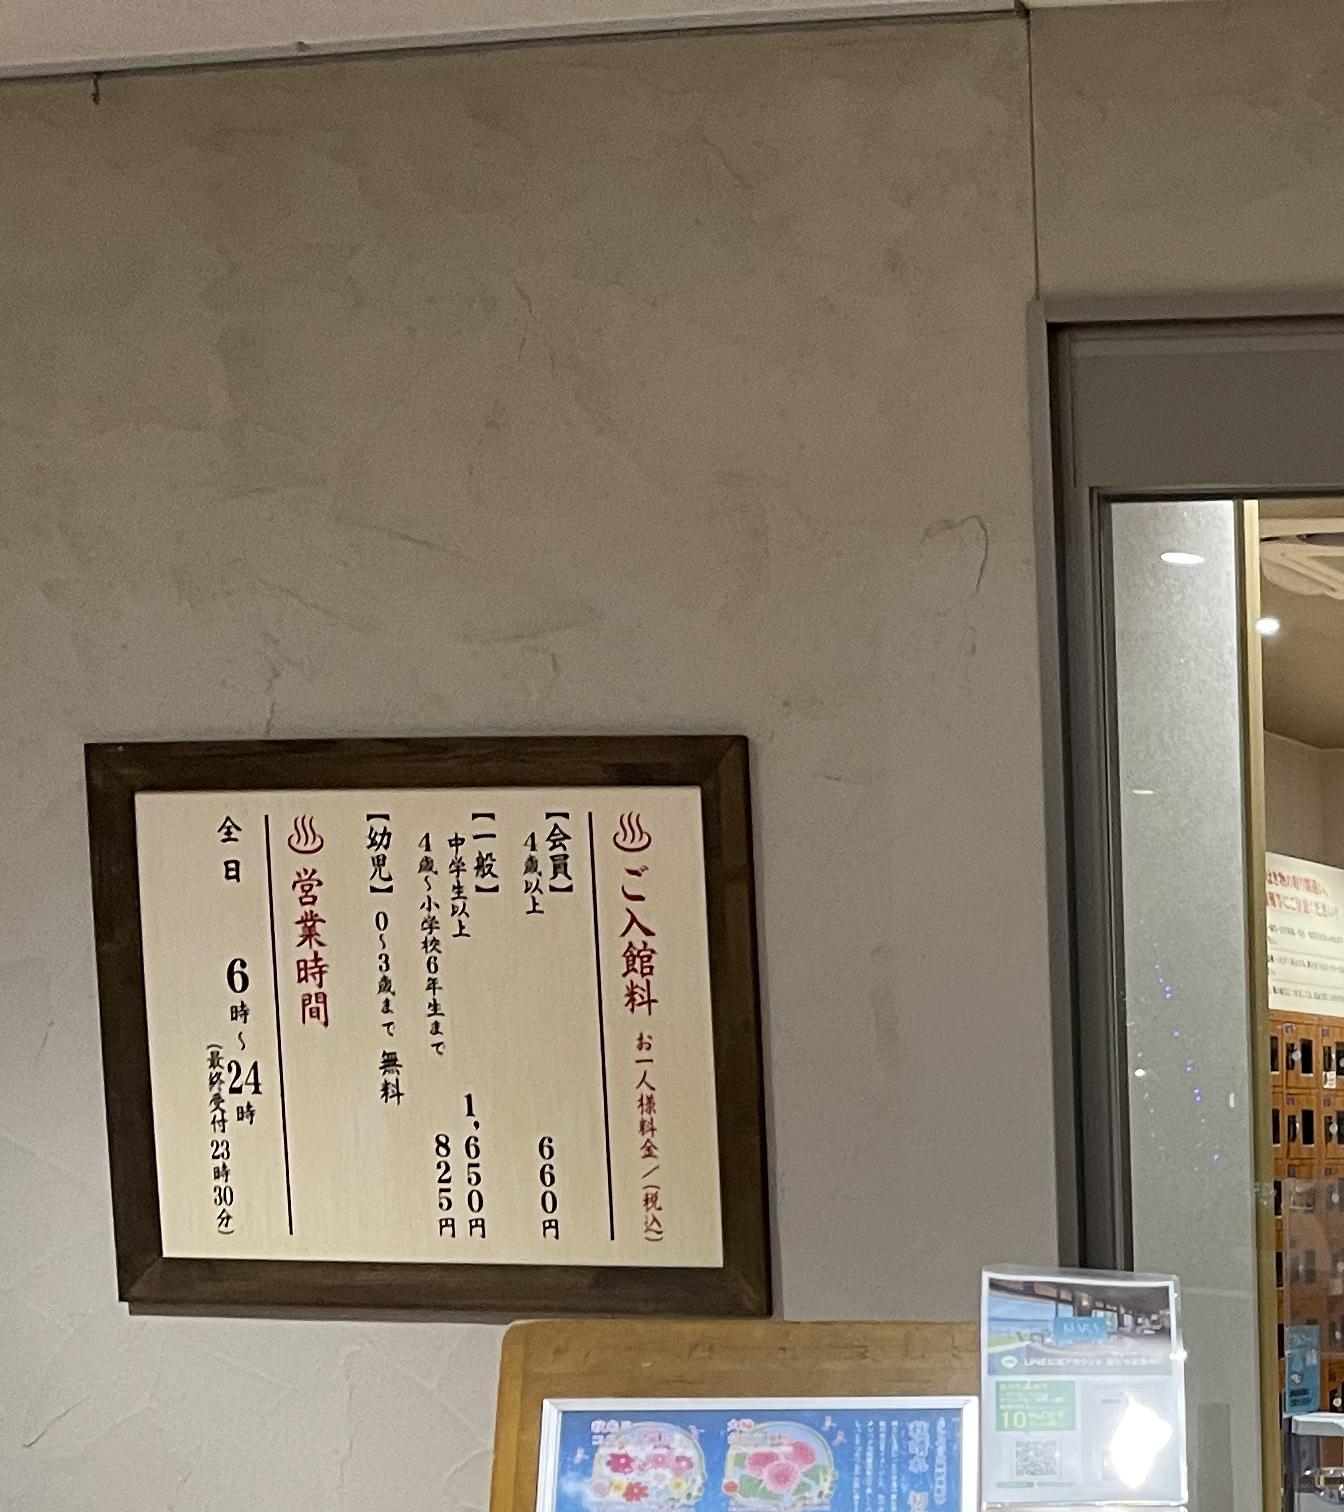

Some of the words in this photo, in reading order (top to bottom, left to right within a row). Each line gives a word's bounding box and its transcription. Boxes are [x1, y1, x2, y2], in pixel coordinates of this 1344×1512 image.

[216, 815, 243, 884] 全日
[366, 812, 394, 894] 【幼児】
[447, 832, 472, 938] 中学生以上
[471, 811, 500, 894] 【一般】
[523, 831, 546, 915] 4歳以上
[545, 811, 574, 894] 【会員】
[291, 867, 331, 1029] 営業時間
[619, 864, 659, 1017] ご入館料
[378, 1050, 405, 1107] 無料
[434, 1133, 456, 1239] 825円
[463, 1092, 486, 1240] 1,650円
[538, 1135, 560, 1241] 660円
